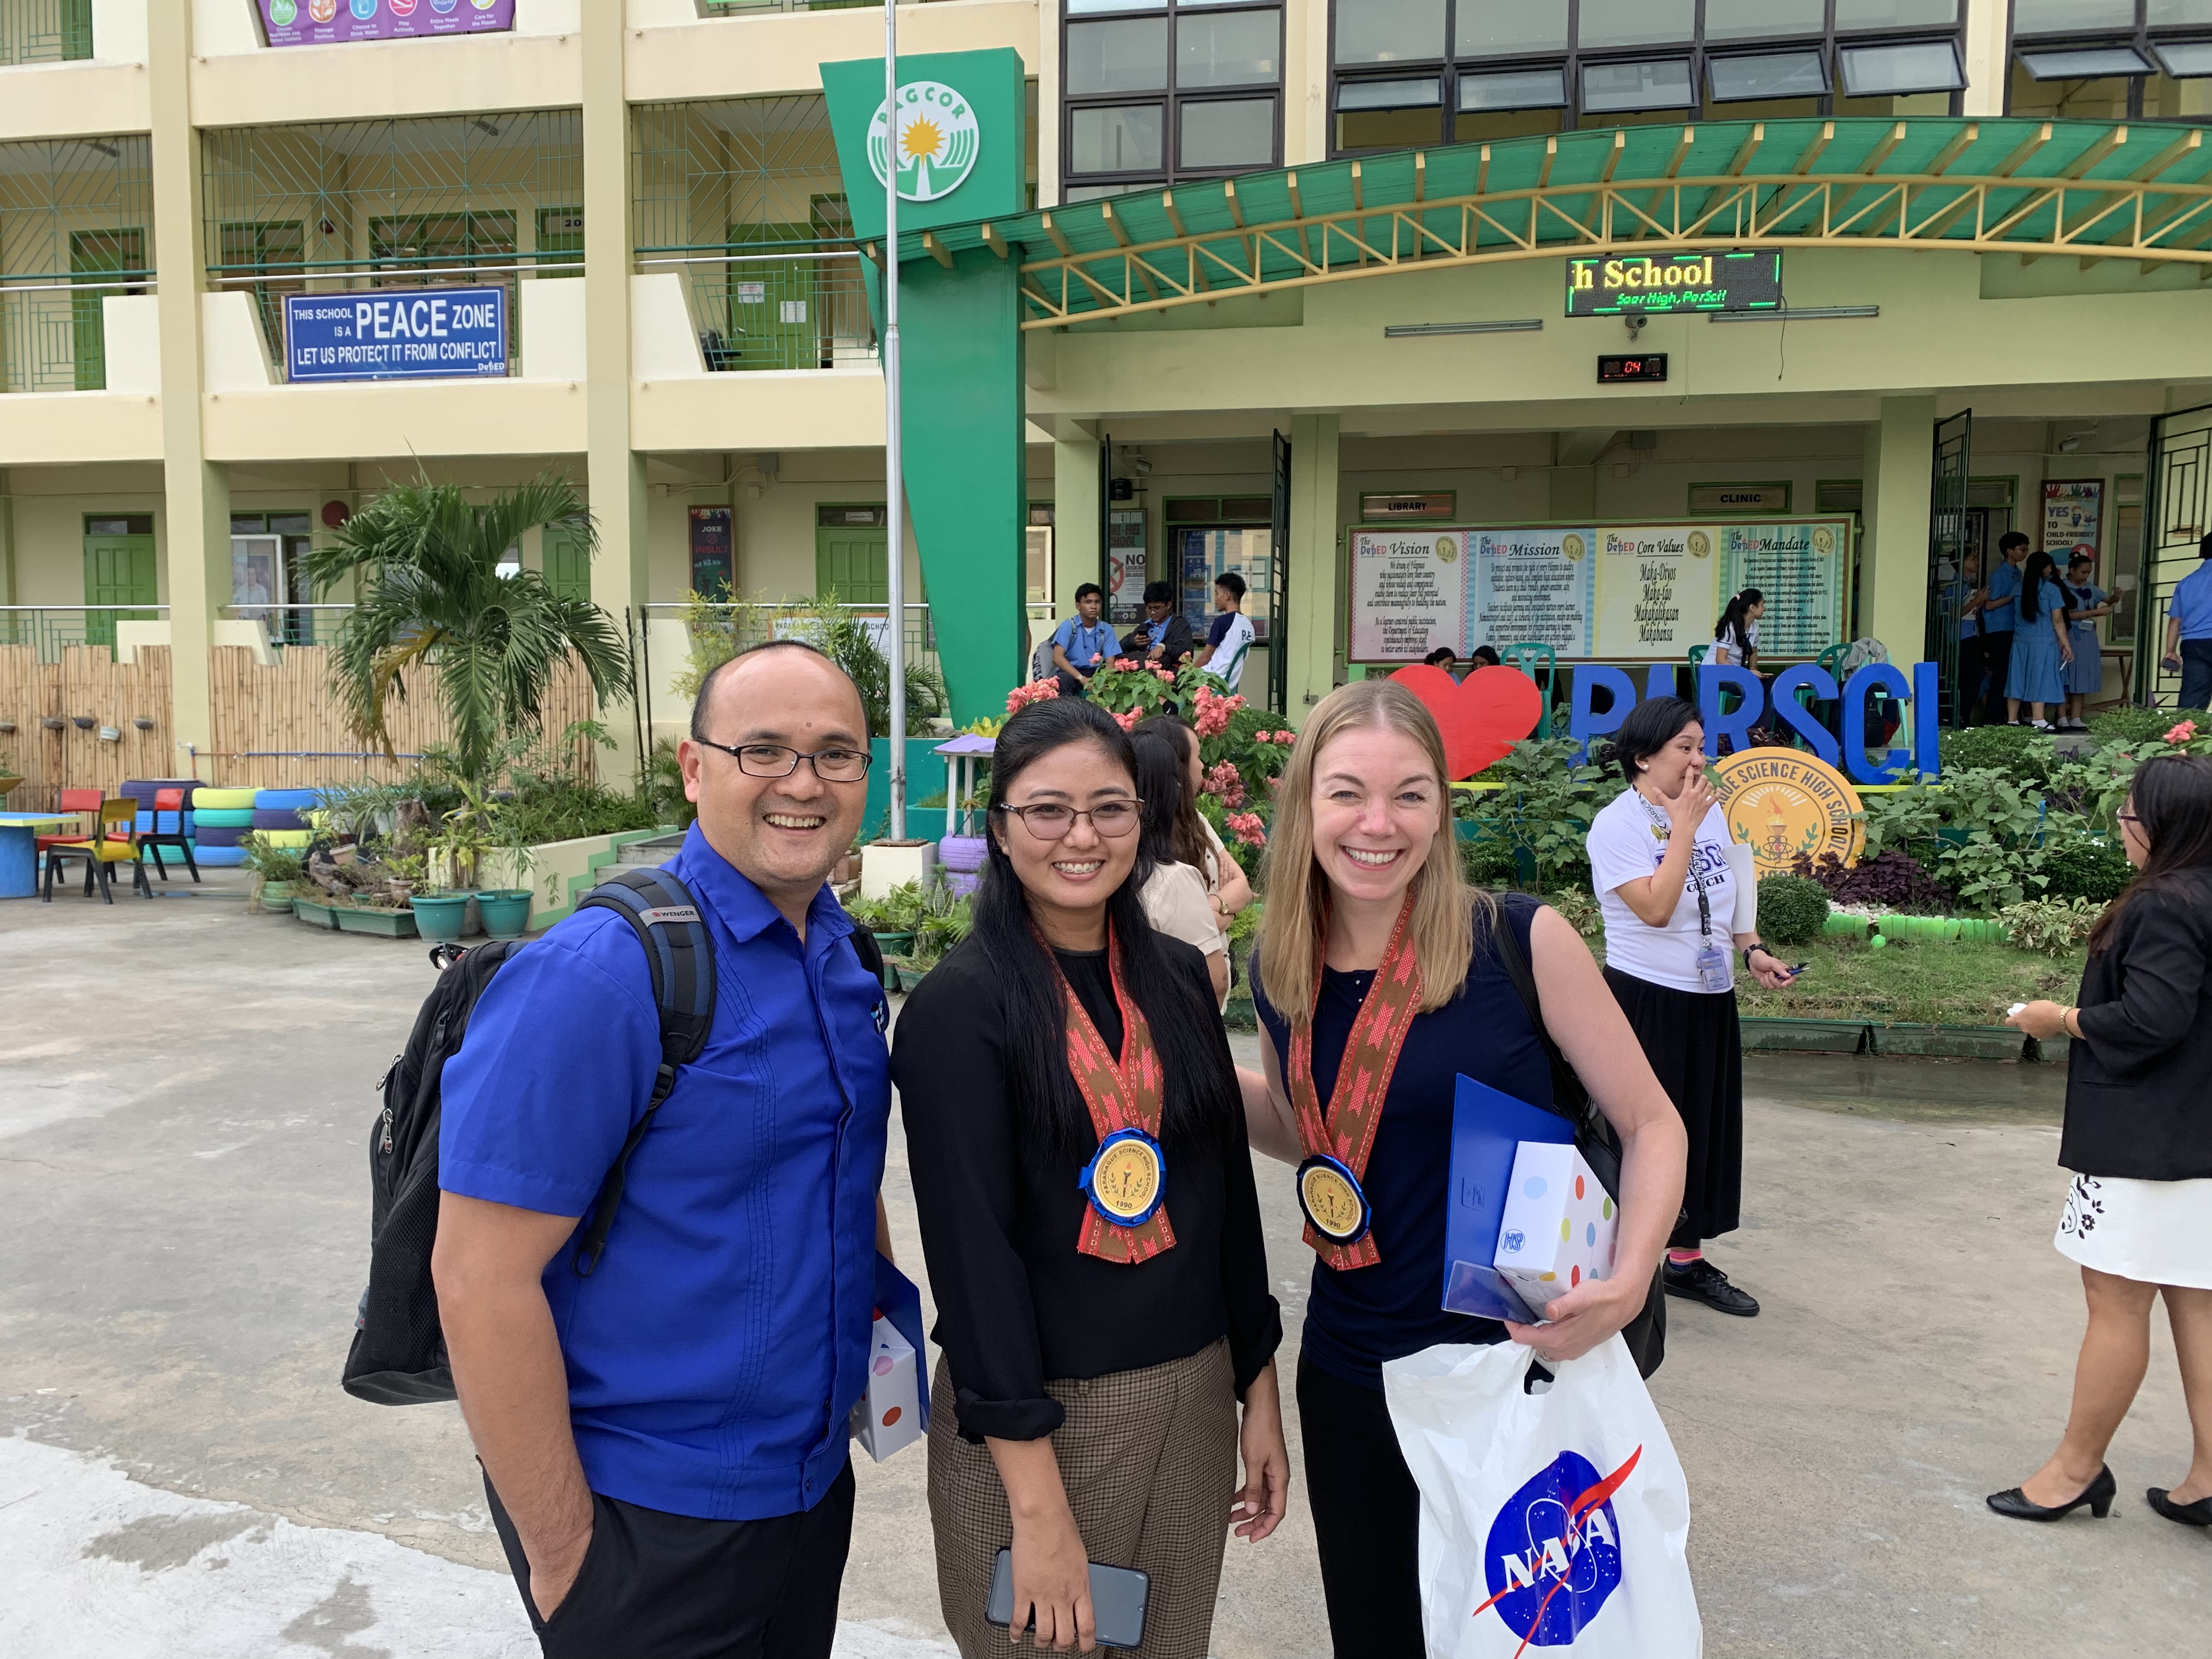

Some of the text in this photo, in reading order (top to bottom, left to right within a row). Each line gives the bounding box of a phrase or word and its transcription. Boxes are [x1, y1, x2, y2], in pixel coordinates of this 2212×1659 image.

[1604, 256, 1713, 288] School
[1617, 292, 1645, 304] Soar
[294, 308, 353, 320] THIS SCHOOL
[356, 300, 495, 340] PEACE ZONE
[334, 326, 352, 337] IS A
[297, 341, 496, 365] LET US PROTECT IT FROM CONFLICT
[1624, 361, 1641, 373] 04
[1719, 493, 1762, 503] CLINIC
[1388, 501, 1427, 511] LIBRARY
[2048, 506, 2069, 517] YES
[1360, 536, 1370, 545] The
[1480, 535, 1491, 545] The
[1607, 533, 1618, 543] The
[1731, 531, 1742, 540] The
[1390, 541, 1430, 555] Vision
[1509, 543, 1560, 556] Mission
[1637, 541, 1655, 554] Core
[1655, 539, 1684, 554] Values
[1759, 536, 1810, 551] Mandate
[1126, 554, 1146, 566] NO
[1640, 560, 1677, 588] Maka-Diyos
[1643, 581, 1672, 606] Maka-tao
[1634, 601, 1679, 626] Makakalikasan
[1639, 621, 1673, 646] Makabansa
[1737, 762, 1800, 784] SCIENCE
[1800, 770, 1835, 801] HIGH
[1826, 799, 1848, 851] SCHOOL
[1686, 874, 1726, 893] COCH
[1102, 1148, 1152, 1200] PARAÑAQUE SCIENCE HIGH SCHOOL
[1316, 1173, 1338, 1183] SCIENCE
[1339, 1182, 1350, 1197] HIGH
[1345, 1199, 1354, 1222] SCHOOL
[1116, 1200, 1132, 1209] 1990
[1326, 1218, 1341, 1228] 1990
